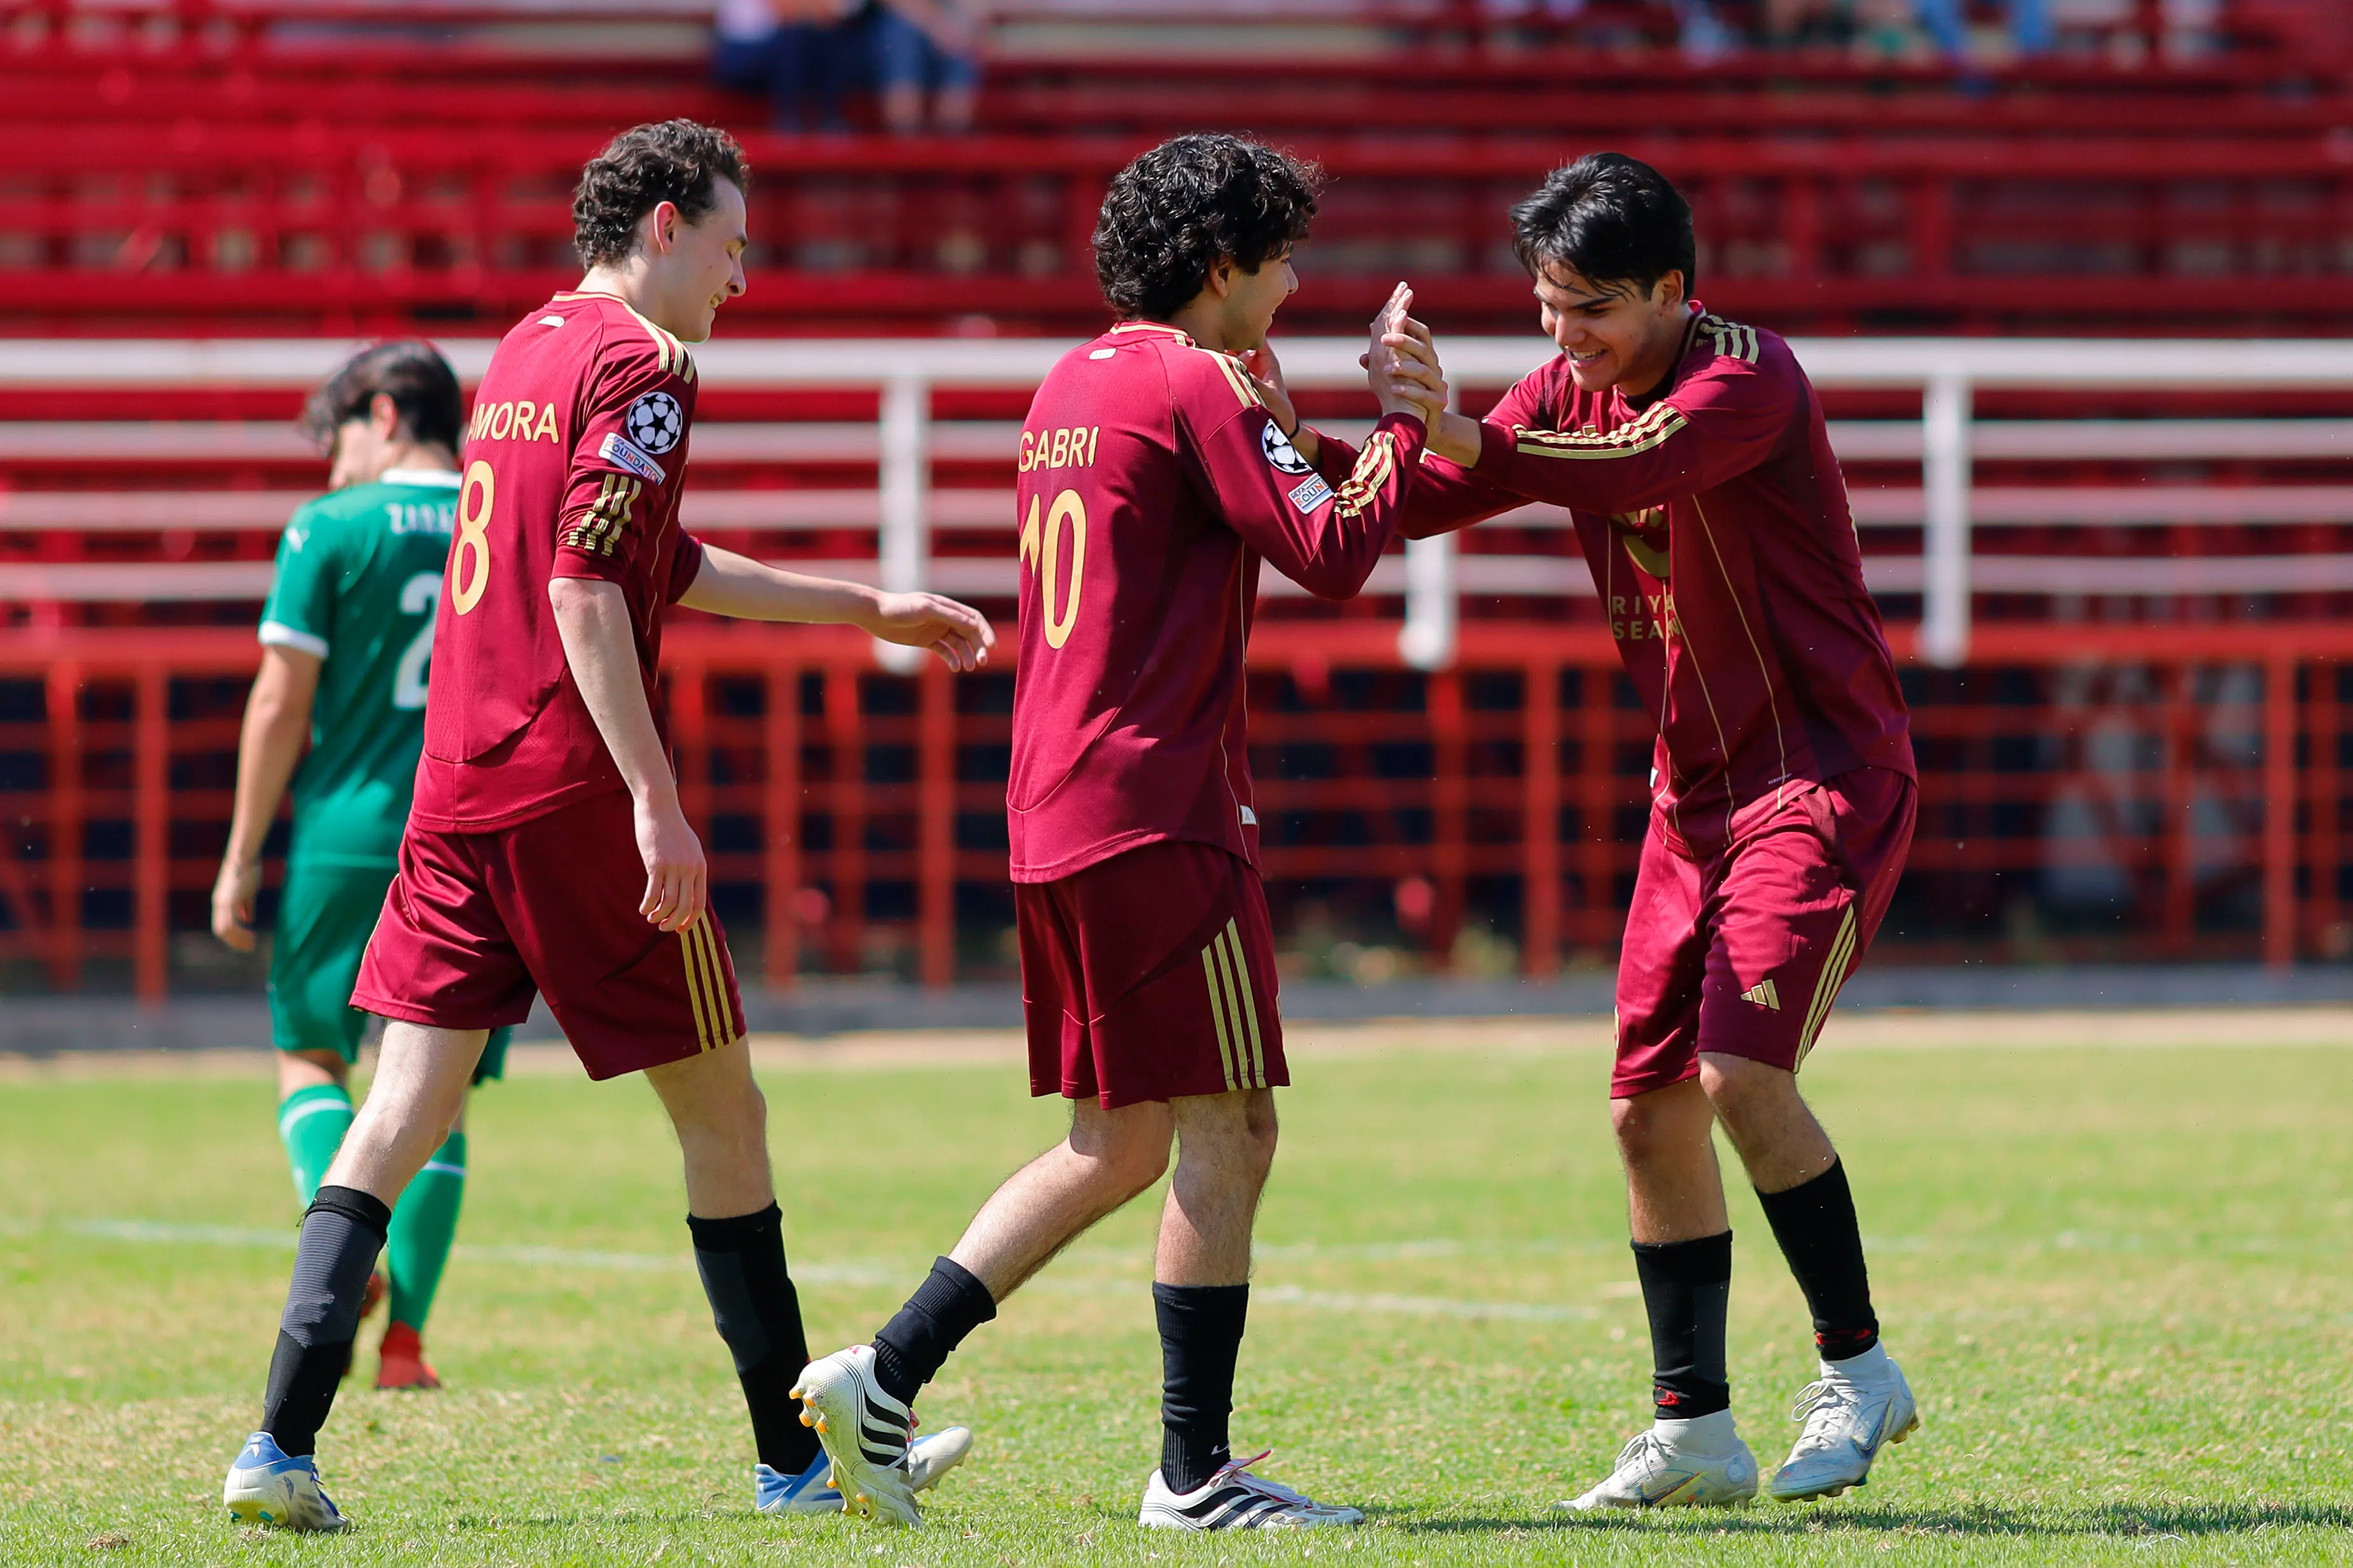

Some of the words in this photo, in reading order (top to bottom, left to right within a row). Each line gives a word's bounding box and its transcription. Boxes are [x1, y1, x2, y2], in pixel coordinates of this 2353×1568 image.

[1018, 426, 1099, 473] GABRI
[1295, 480, 1327, 506] FOUN
[451, 460, 494, 616] 8
[1019, 489, 1087, 649] 10
[394, 572, 445, 709] 2
